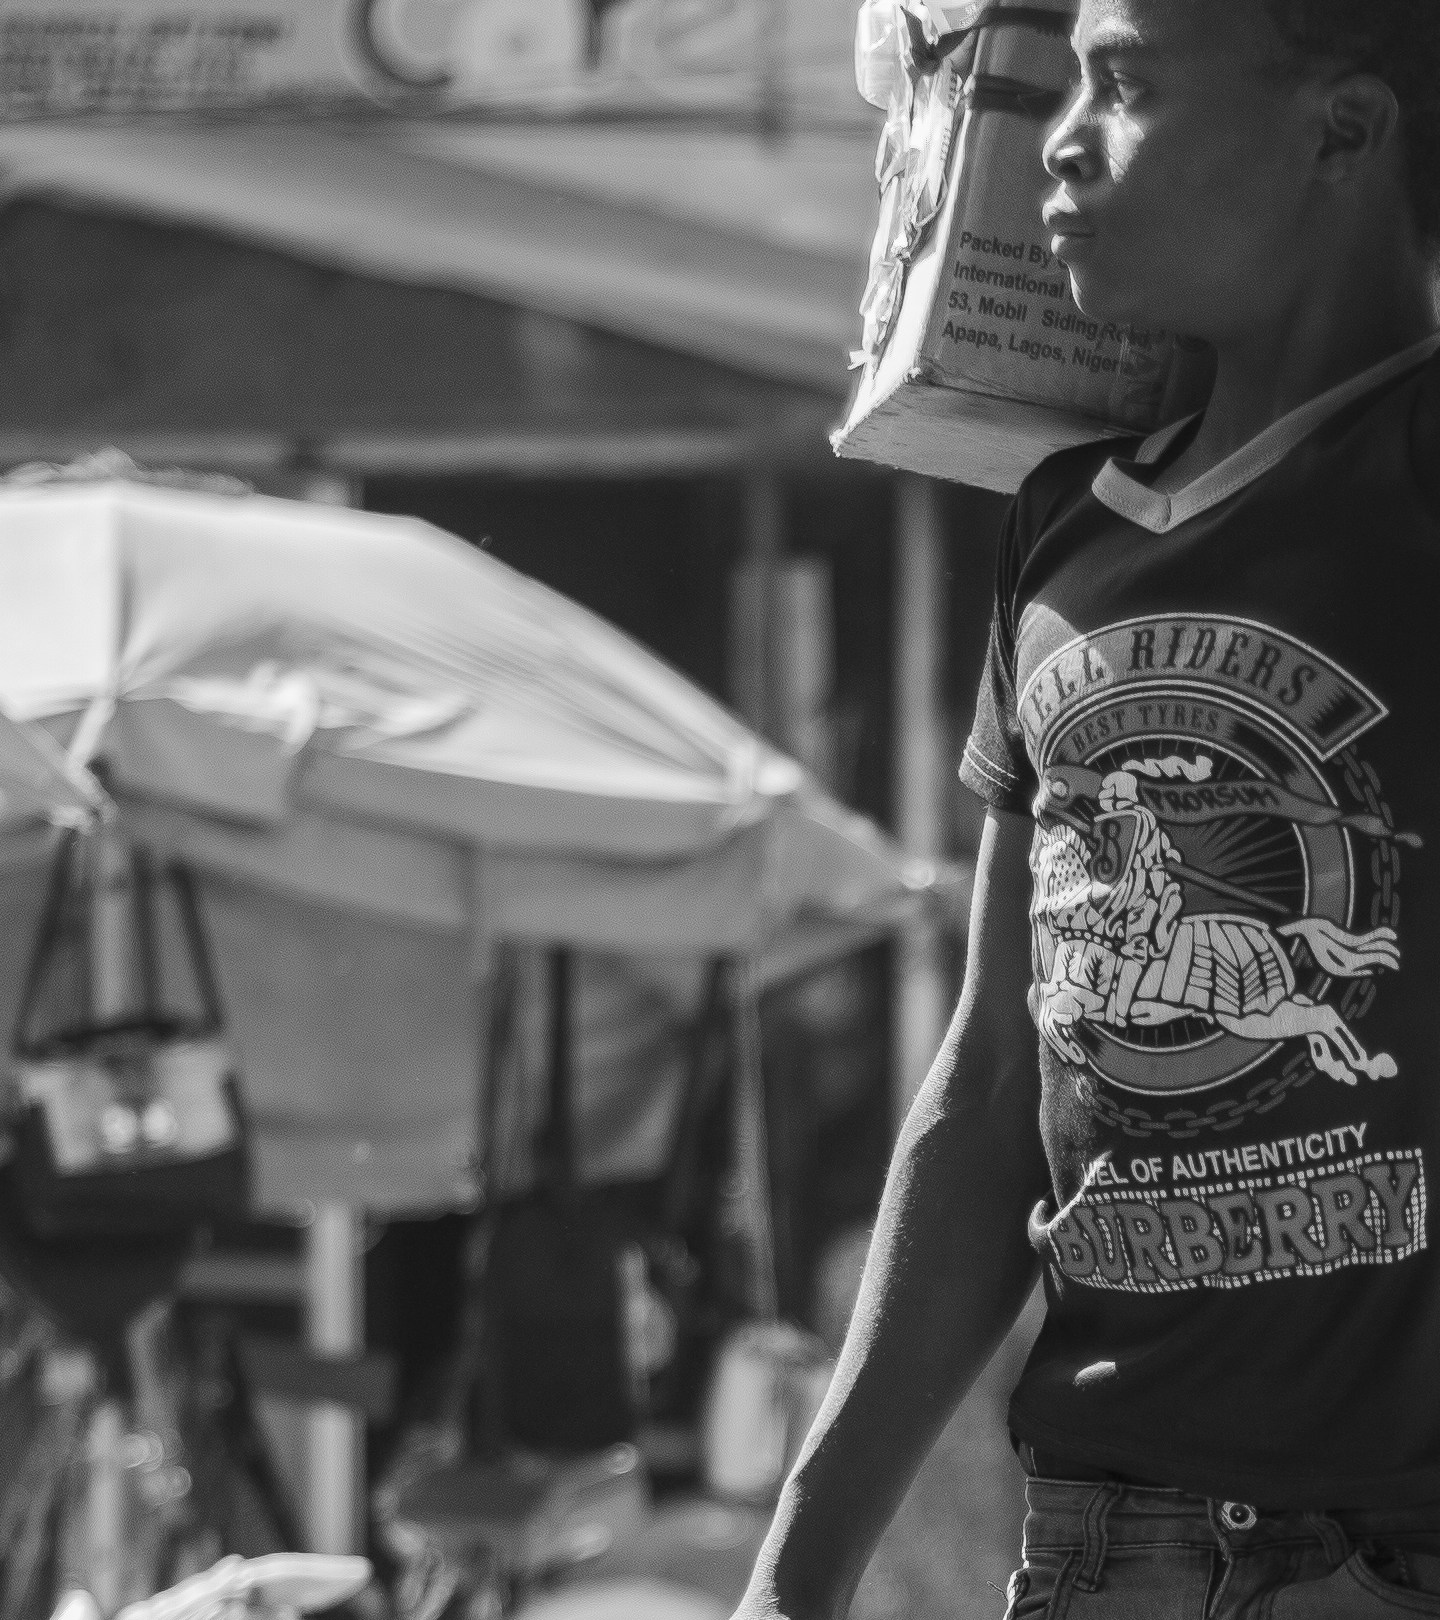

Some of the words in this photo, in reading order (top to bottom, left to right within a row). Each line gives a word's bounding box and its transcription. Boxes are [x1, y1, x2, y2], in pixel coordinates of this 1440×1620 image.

[959, 230, 1025, 260] Packed
[1028, 244, 1052, 269] By
[953, 260, 1065, 298] International
[947, 289, 972, 313] 53,
[1040, 308, 1099, 341] Siding
[941, 320, 1003, 352] Apapa,
[1007, 333, 1067, 365] Lagos,
[1024, 646, 1105, 726] ELL
[1126, 627, 1318, 706] RIDERS
[1071, 712, 1125, 755] BEST
[1138, 702, 1221, 733] TYRES
[1130, 1157, 1164, 1184] OF
[1171, 1121, 1369, 1182] AUTHENTICITY
[1057, 1162, 1418, 1284] BURBERRY
